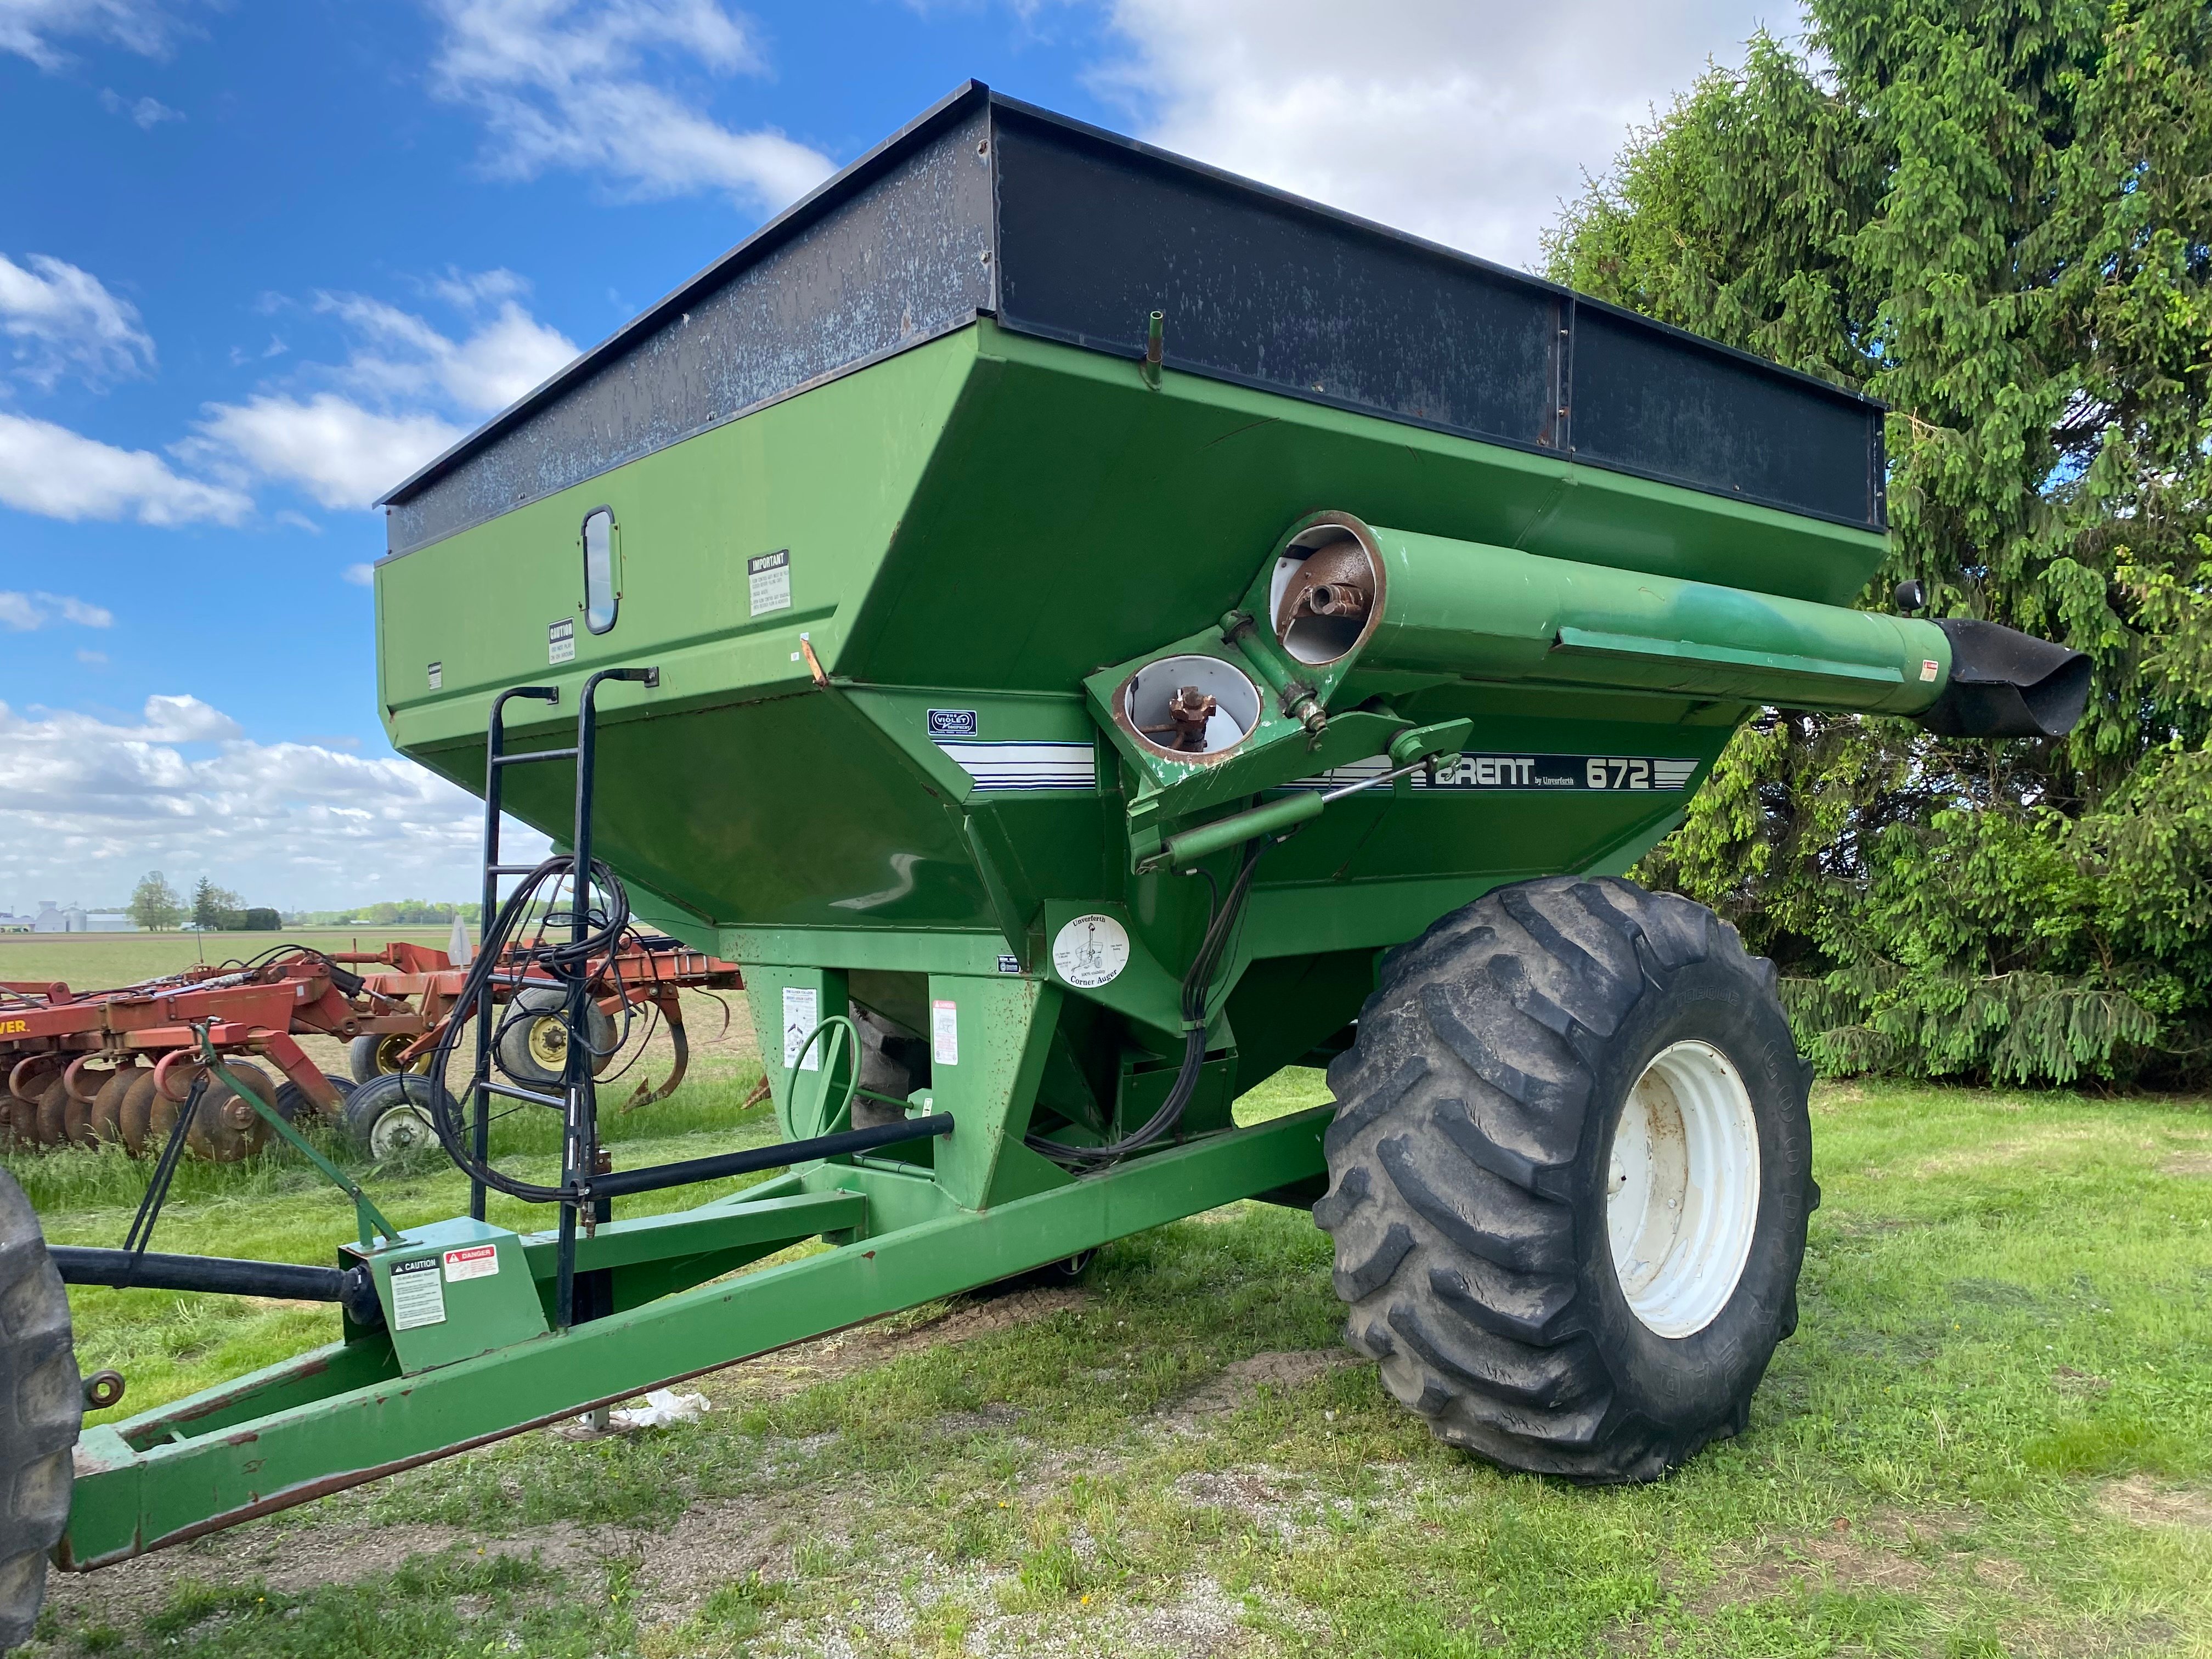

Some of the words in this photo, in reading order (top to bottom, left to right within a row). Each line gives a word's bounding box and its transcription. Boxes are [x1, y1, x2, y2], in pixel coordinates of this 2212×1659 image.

[752, 552, 785, 571] IMPORTANT
[550, 623, 572, 640] CAUTION
[1534, 777, 1542, 786] by
[1542, 776, 1574, 785] Unverferth
[1587, 758, 1649, 789] 672
[1073, 915, 1106, 927] Unverferth
[1070, 975, 1094, 986] Corner
[1097, 969, 1118, 984] Auger
[461, 1249, 491, 1260] DANGER
[405, 1259, 436, 1271] CAUTION
